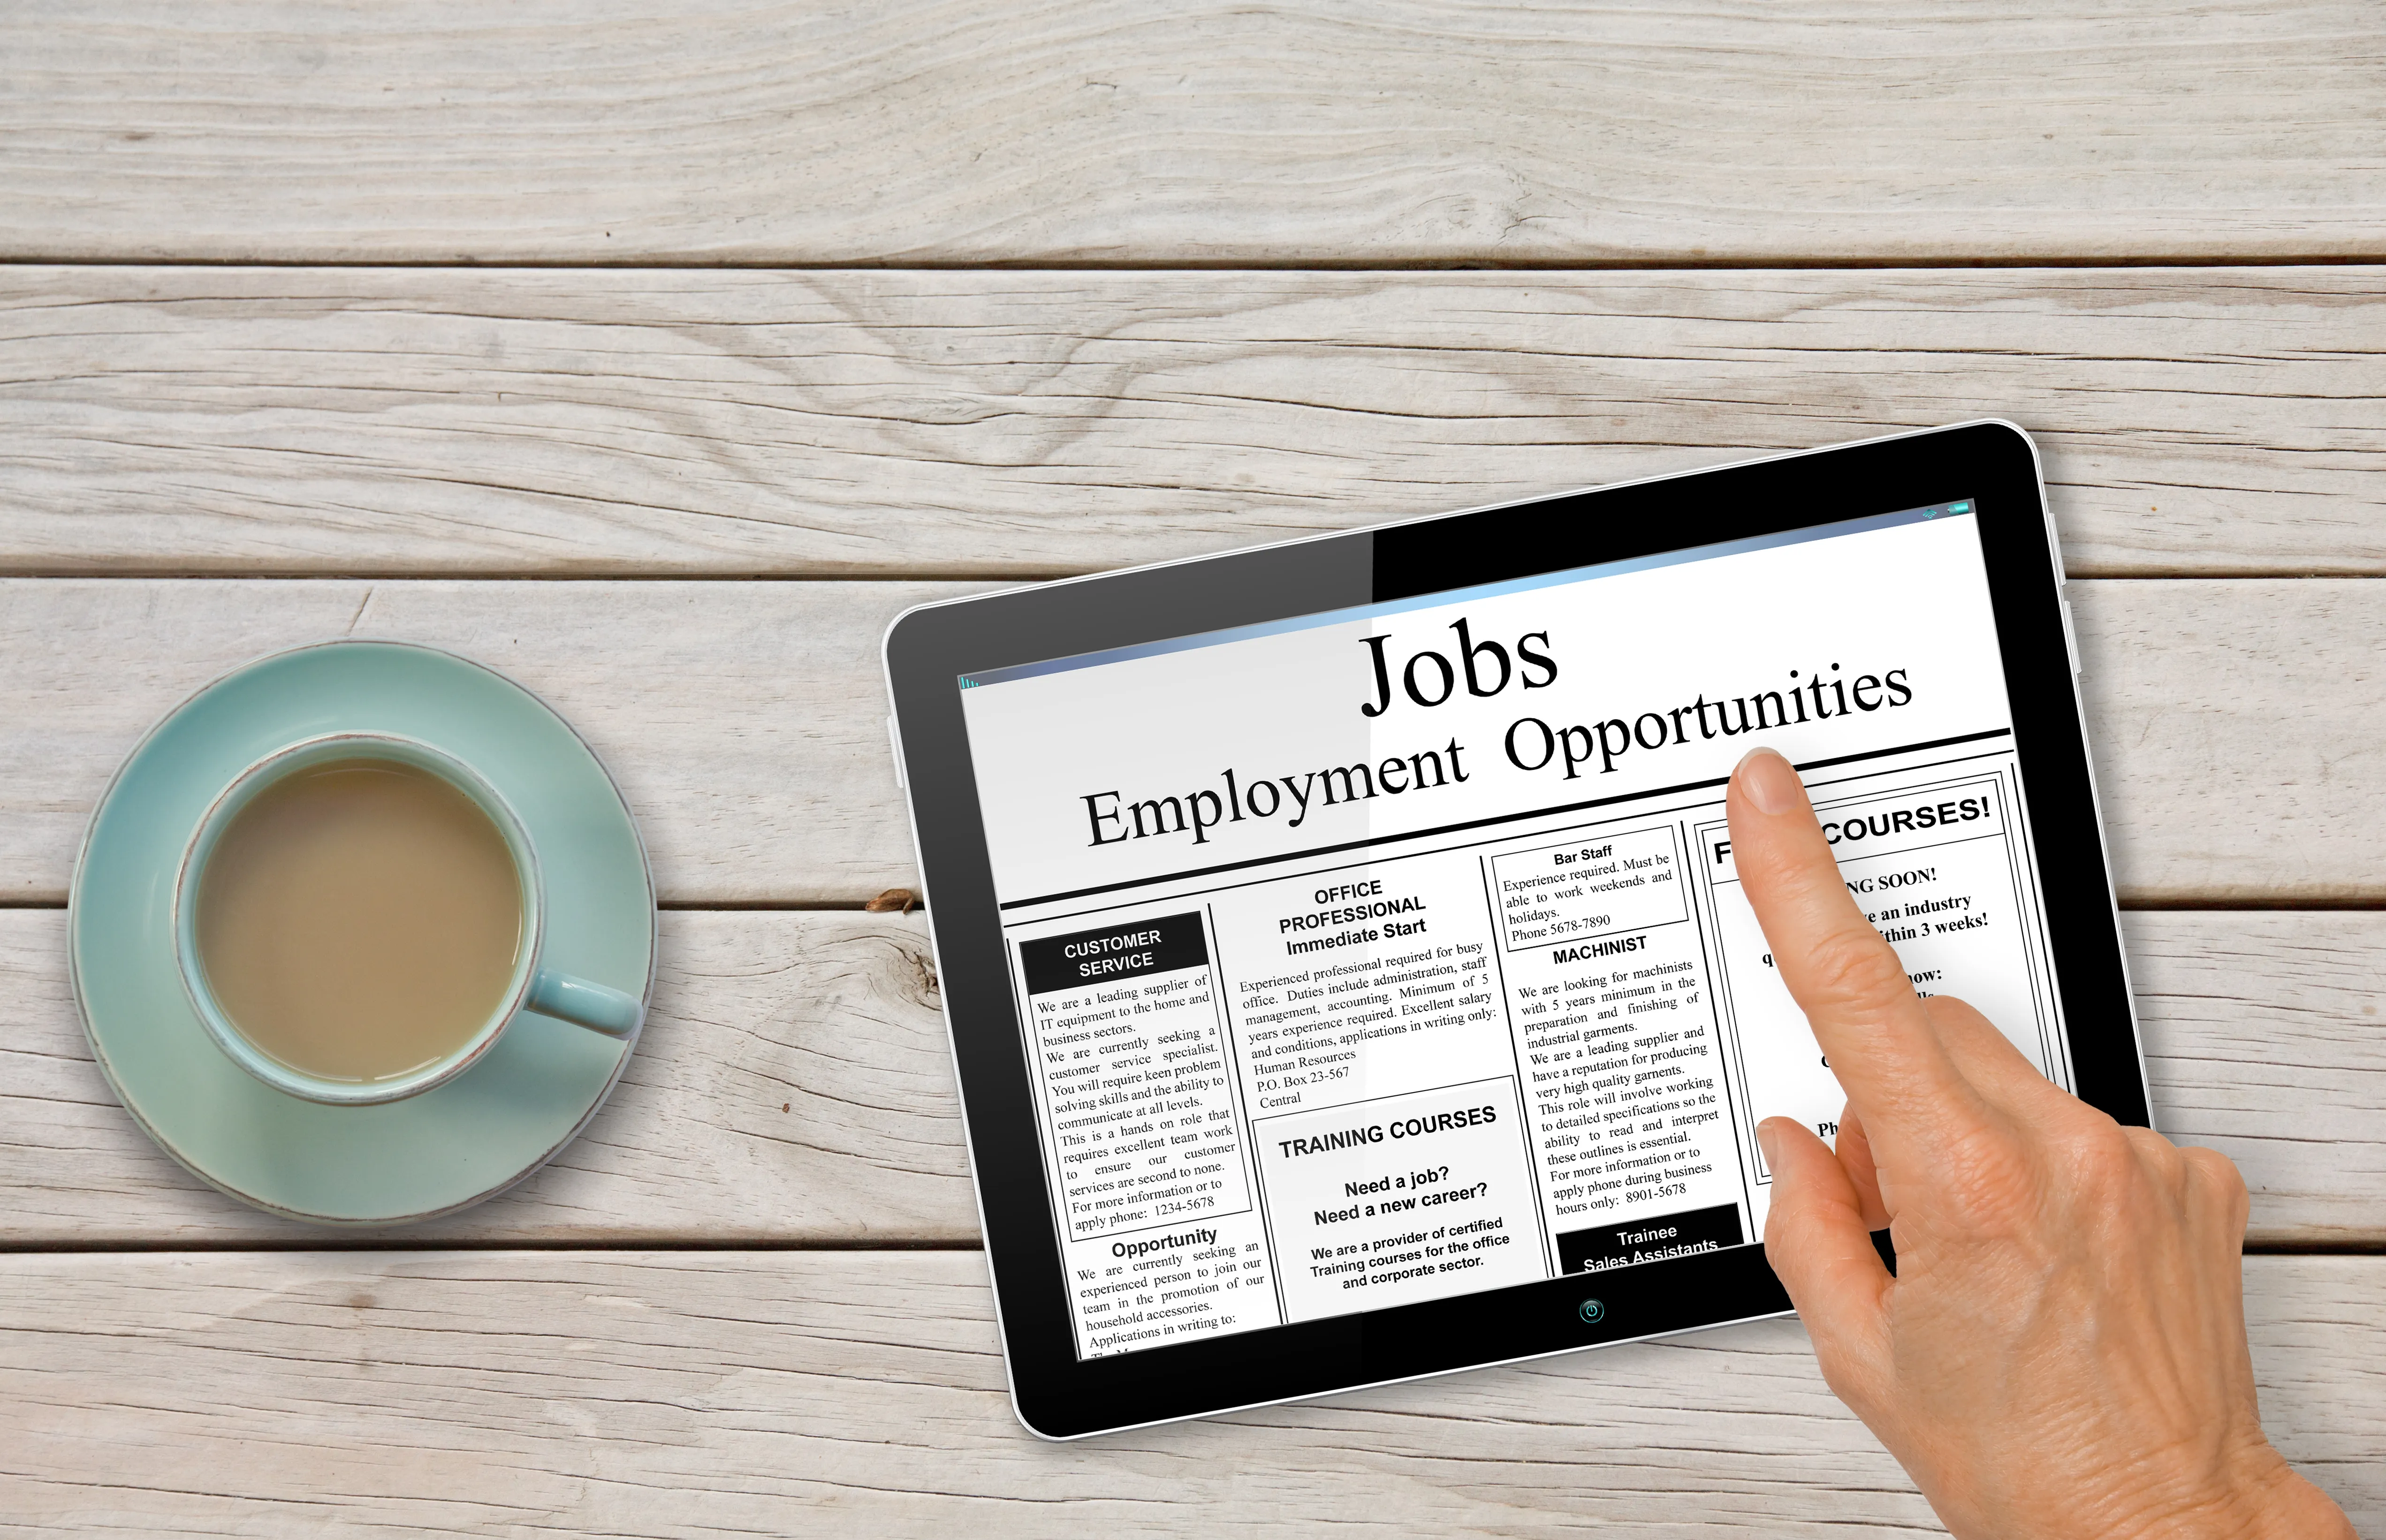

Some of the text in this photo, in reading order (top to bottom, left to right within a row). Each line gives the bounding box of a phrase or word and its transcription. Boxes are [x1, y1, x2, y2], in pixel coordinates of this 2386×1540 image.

[1358, 617, 1558, 718] Jobs
[1079, 662, 1912, 847] Employment Opportunities
[1821, 796, 1990, 845] COURSES!
[1554, 844, 1612, 865] Bar Staff
[1503, 854, 1670, 892] Experience required. Must be
[1506, 869, 1672, 909] able to work weekends and
[1878, 867, 1937, 890] SOON!
[1314, 879, 1383, 904] OFFICE
[1881, 909, 1900, 921] an
[1904, 896, 1971, 917] industry
[1279, 895, 1427, 934] PROFESSIONAL
[1508, 909, 1560, 925] holidays.
[1511, 914, 1611, 941] Phone 5678-7890
[1920, 922, 1930, 937] 3
[1934, 912, 1988, 934] weeks!
[1064, 930, 1162, 958] CUSTOMER
[1286, 918, 1427, 956] Immediate Start
[1552, 935, 1647, 965] MACHINIST
[1079, 951, 1154, 977] SERVICE
[1240, 943, 1483, 993] Experienced professional required for busy
[1242, 956, 1487, 1009] office. Duties include administration, staff
[1245, 973, 1489, 1026] management, accounting. Minimum of 5
[1040, 990, 1210, 1031] IT equipment to the home and
[1248, 993, 1492, 1046] years experience required. Excellent salary
[1524, 991, 1700, 1035] preparation and finishing of
[1042, 1024, 1136, 1047] business sectors.
[1251, 1008, 1497, 1059] and conditions, applications in writing only:
[1527, 1023, 1638, 1049] industrial garments.
[1049, 1043, 1218, 1080] customer service specialist.
[1051, 1060, 1222, 1097] You will require keen problem
[1254, 1051, 1356, 1076] Human Resources
[1257, 1066, 1349, 1092] P.O. Box 23-567
[1260, 1091, 1301, 1109] Central
[1535, 1066, 1685, 1099] very high quality garnents.
[1057, 1096, 1203, 1130] communicate at all levels.
[1064, 1124, 1233, 1164] requires excellent team work
[1278, 1105, 1497, 1159] TRAINING COURSES
[1547, 1130, 1691, 1166] these outlines is essential.
[1345, 1166, 1449, 1198] Need a job?
[1553, 1164, 1712, 1201] apply phone during business
[1555, 1182, 1687, 1216] hours only: 8901-5678
[1075, 1196, 1215, 1232] apply phone: 1234-5678
[1314, 1182, 1488, 1226] Need a new career?
[1111, 1228, 1217, 1259] Opportunity
[1310, 1216, 1503, 1260] We are a provider of certified
[1616, 1227, 1678, 1246] Trainee
[1309, 1235, 1510, 1278] Training courses for the office
[1583, 1239, 1718, 1271] Sales Assistants
[1080, 1259, 1261, 1298] experienced person to join our
[1343, 1257, 1484, 1290] and corporate sector.
[1085, 1303, 1213, 1331] household accessories.
[1089, 1315, 1236, 1349] Applications in writing to:
